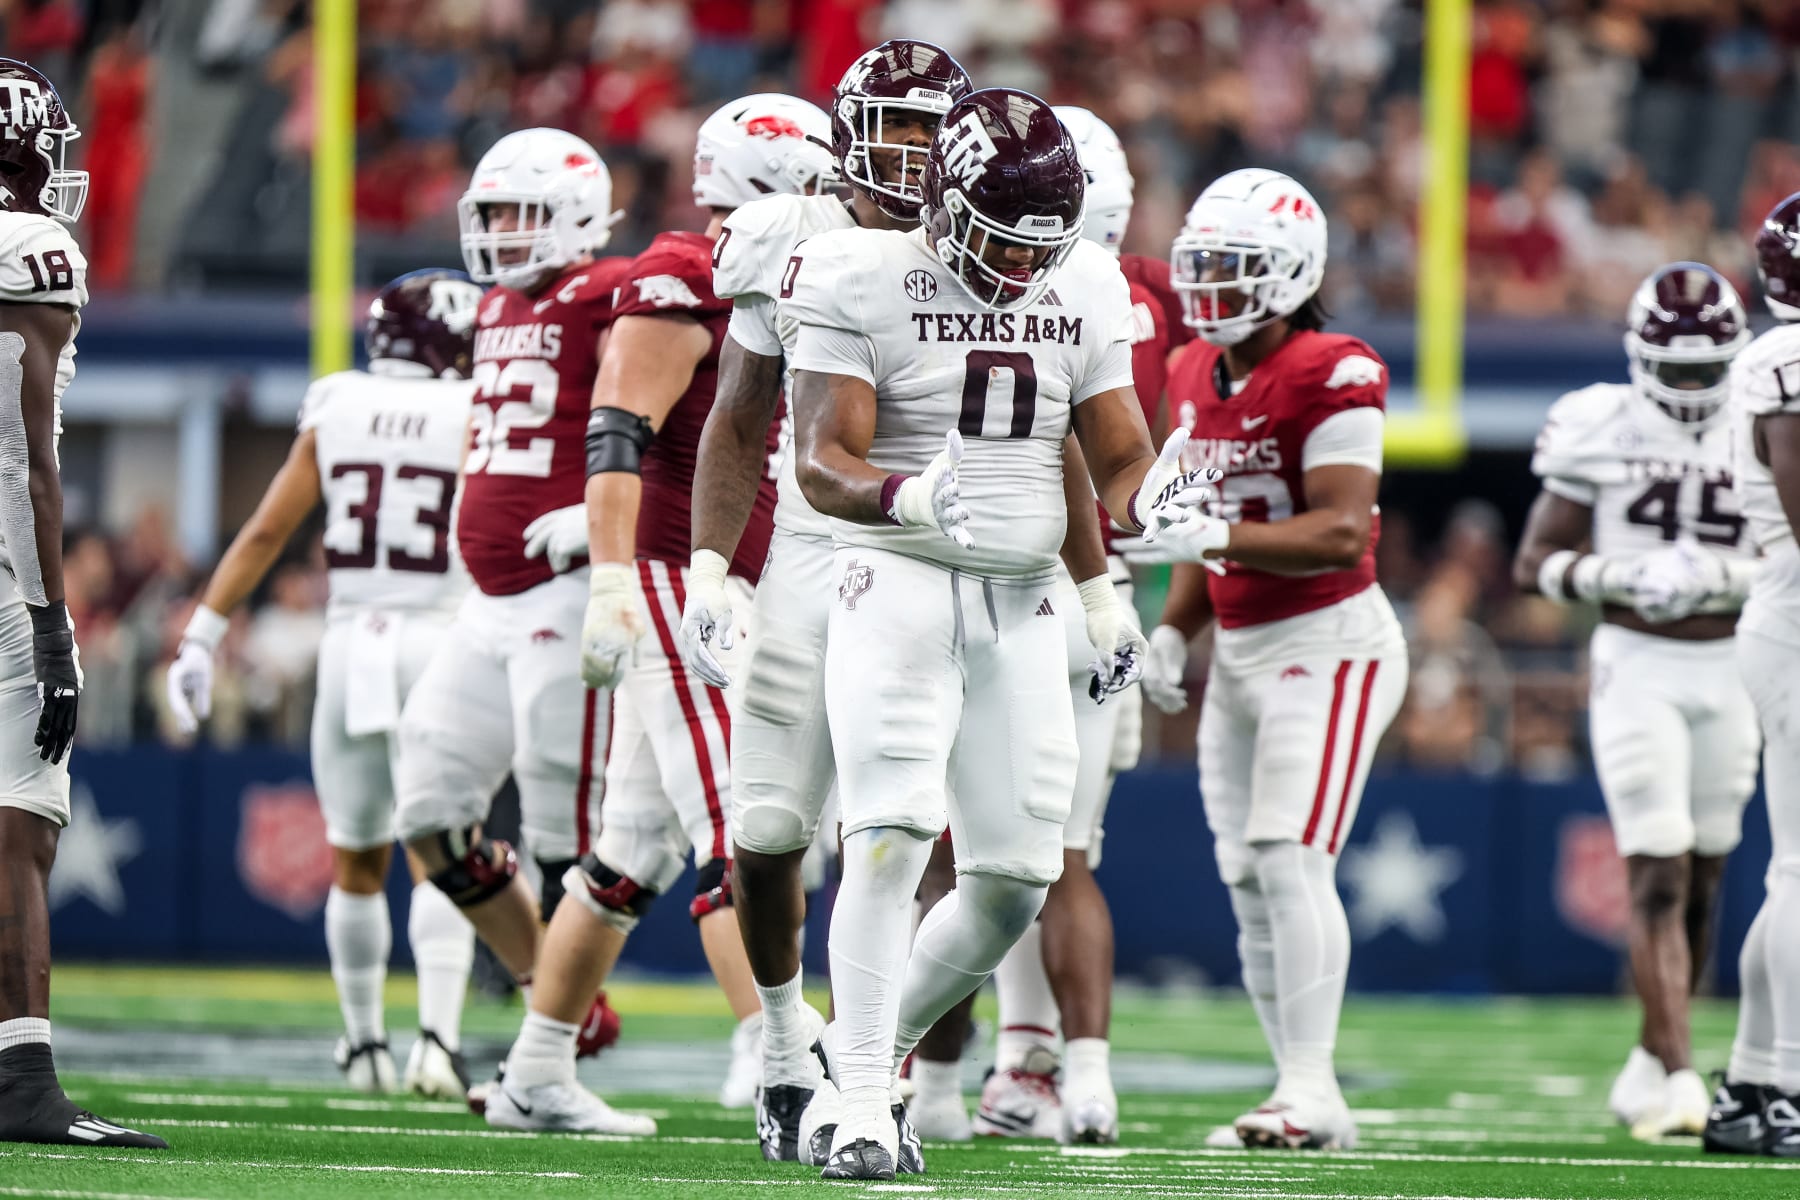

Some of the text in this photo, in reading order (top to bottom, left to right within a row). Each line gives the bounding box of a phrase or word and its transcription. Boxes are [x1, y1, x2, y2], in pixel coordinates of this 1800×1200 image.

[1031, 218, 1056, 227] AGGIES
[22, 249, 74, 293] 18
[904, 270, 937, 301] SEC
[911, 312, 1083, 345] TEXAS A&M
[957, 349, 1037, 438] 0
[328, 462, 457, 573] 33
[1627, 480, 1747, 547] 45
